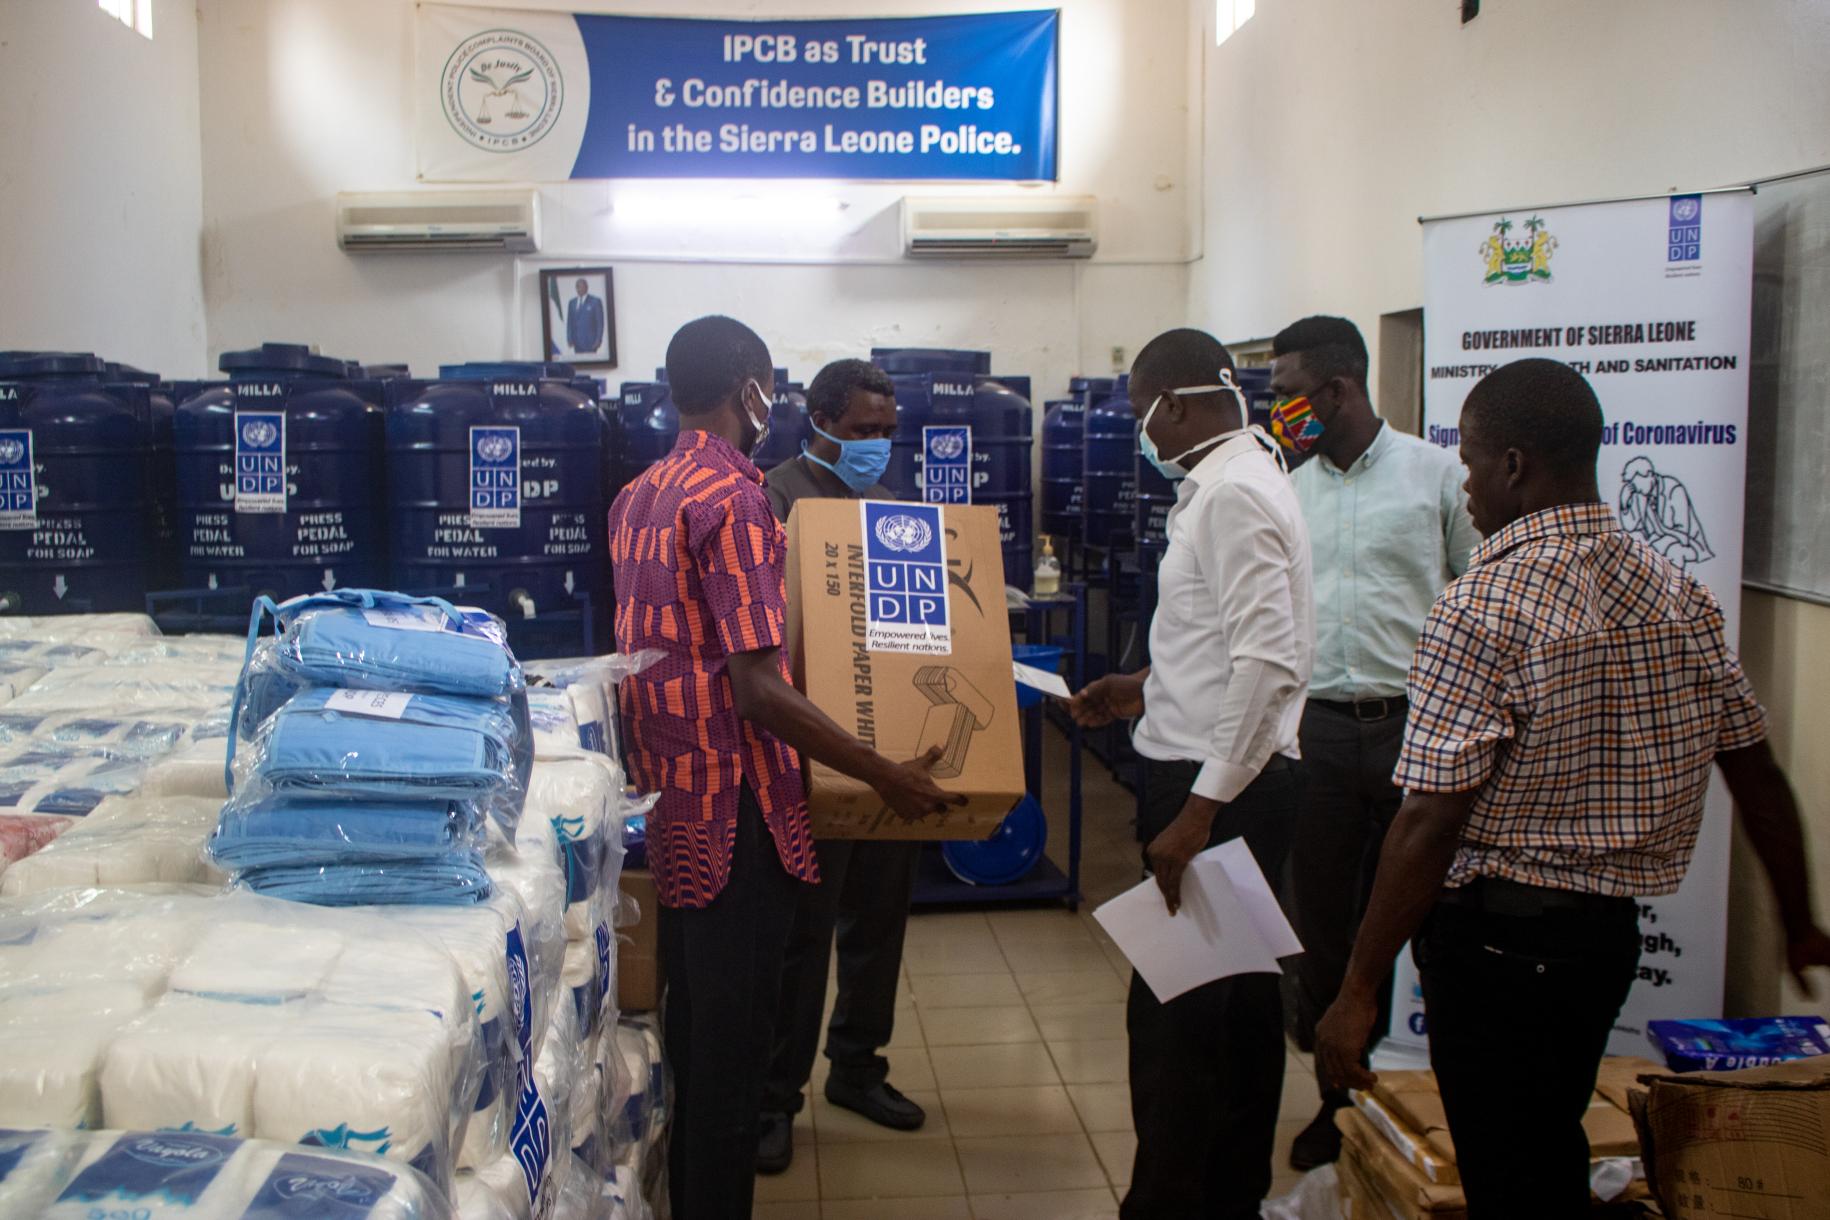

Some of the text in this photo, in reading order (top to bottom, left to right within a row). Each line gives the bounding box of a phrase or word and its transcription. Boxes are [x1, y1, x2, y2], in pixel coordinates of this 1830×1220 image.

[723, 35, 927, 65] IPCB as Trust
[655, 78, 995, 110] & Confidence Builders
[628, 124, 1022, 155] in the Sierra Leone Police.
[1462, 321, 1696, 351] GOVERNMENT OF SIERRA LEONE
[1595, 360, 1630, 373] AND
[1634, 356, 1737, 372] SANITATION
[237, 383, 283, 397] MILLA
[493, 383, 537, 396] MILLA
[932, 383, 975, 396] MILLA
[1602, 422, 1619, 445] of
[1623, 420, 1737, 445] Coronavirus
[196, 514, 229, 526] PRESS
[300, 512, 343, 526] PRESS
[439, 514, 470, 526] PRES
[33, 532, 87, 546] PEDAL
[193, 528, 232, 543] PEDAL
[297, 526, 348, 542] PEDAL
[434, 528, 484, 543] PEDAL
[549, 527, 588, 541] PEDAL
[28, 548, 95, 559] FOR SOAP
[206, 545, 245, 557] WATER
[292, 541, 355, 557] FOR SOAP
[427, 546, 498, 558] FOR WATER
[567, 543, 591, 554] SOAP
[825, 541, 841, 597] 20 x 150
[869, 629, 927, 641] Empowered
[847, 544, 876, 749] INTERFOLD PAPER WHIT
[871, 641, 949, 652] Resilient nations.
[1705, 1055, 1718, 1070] A
